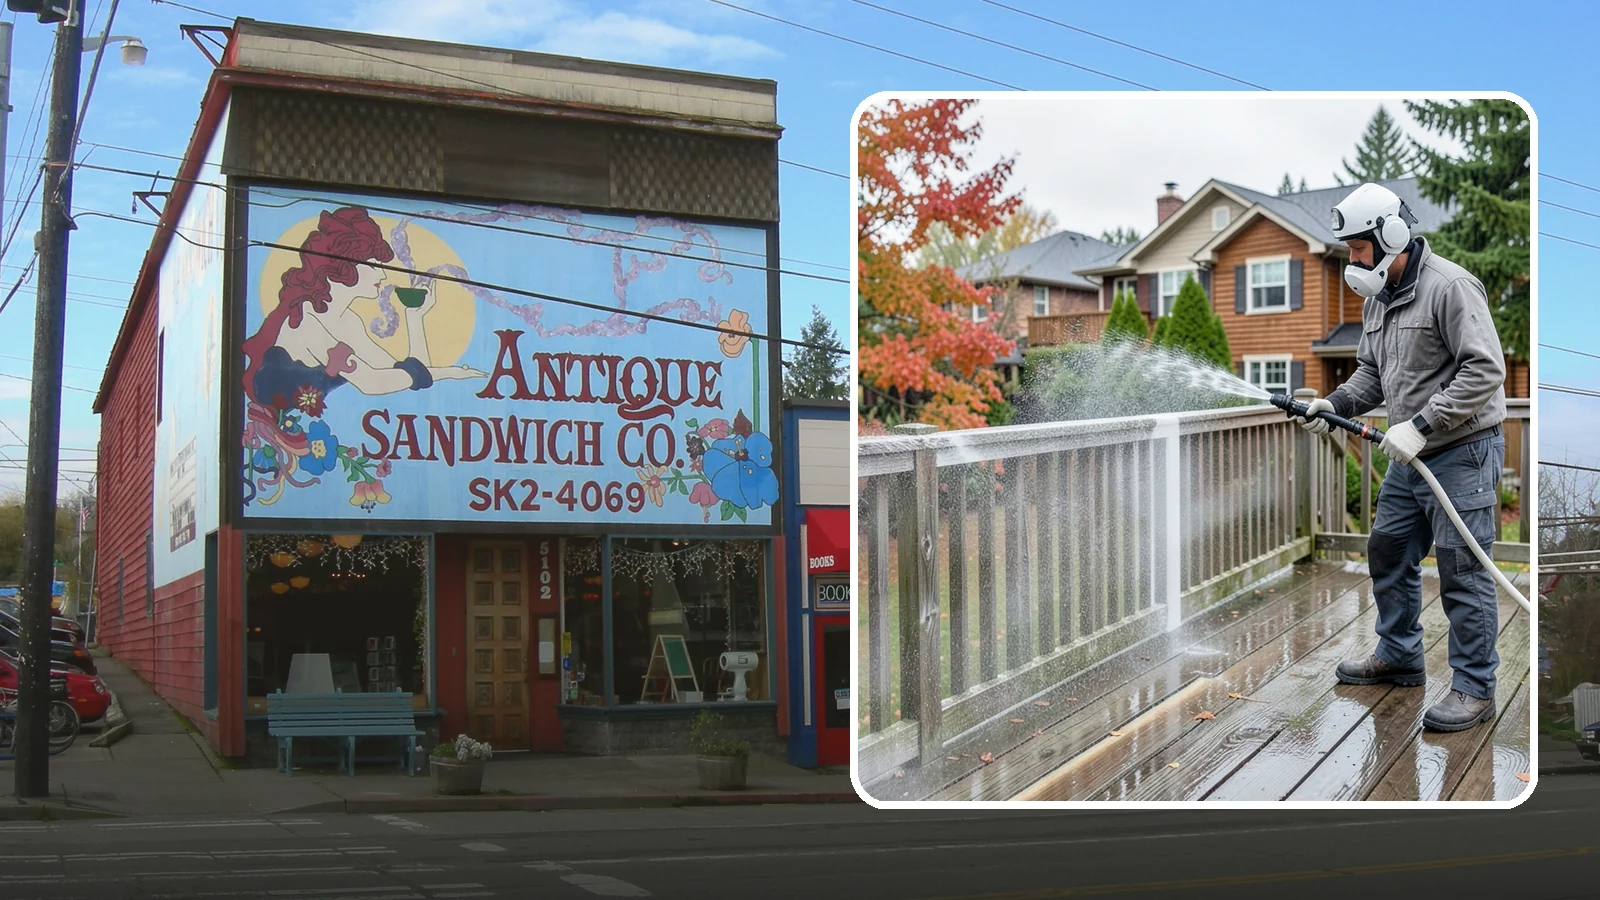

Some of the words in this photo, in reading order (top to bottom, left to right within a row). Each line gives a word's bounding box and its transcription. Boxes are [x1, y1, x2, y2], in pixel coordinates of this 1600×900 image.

[475, 328, 723, 421] ANTIQUE
[361, 409, 604, 467] SANDWICH
[617, 420, 685, 469] CO.
[469, 477, 646, 513] SK2-4069
[540, 542, 551, 600] 5102
[809, 555, 834, 568] BOOKS
